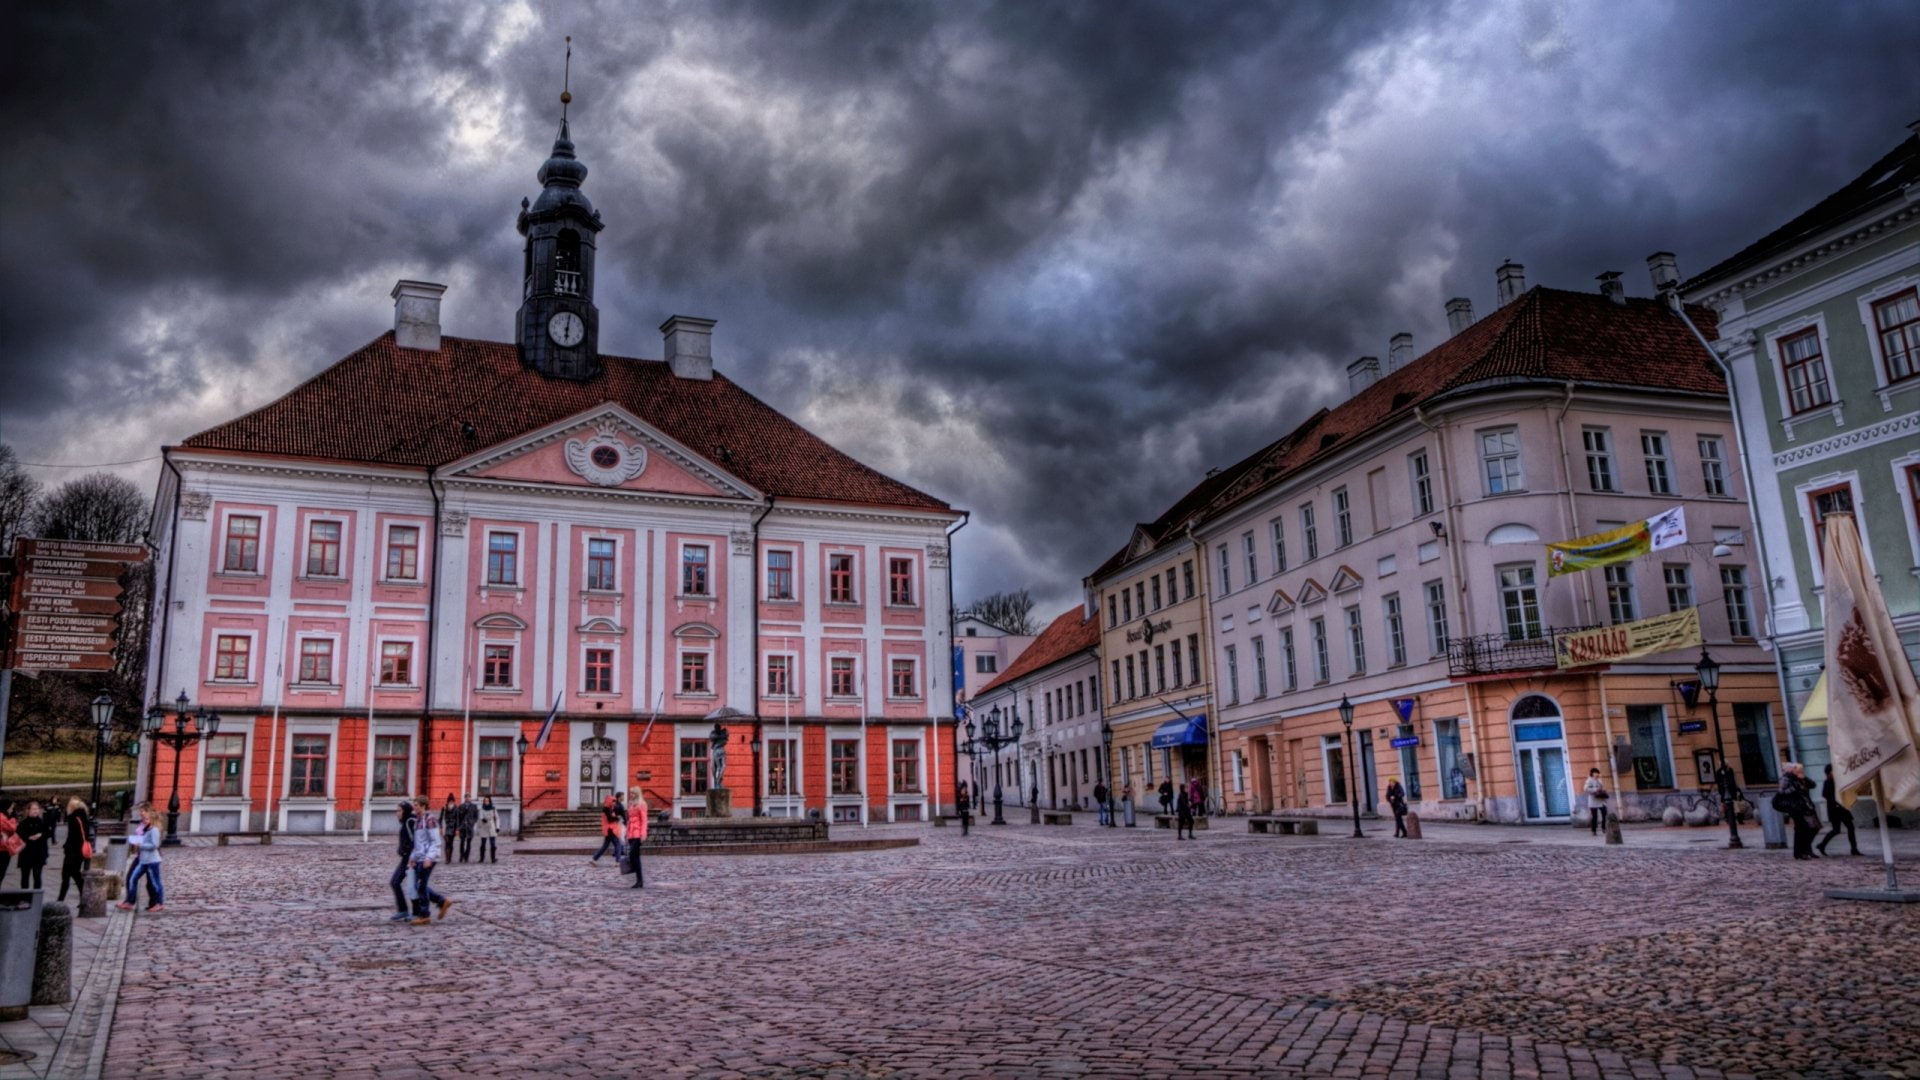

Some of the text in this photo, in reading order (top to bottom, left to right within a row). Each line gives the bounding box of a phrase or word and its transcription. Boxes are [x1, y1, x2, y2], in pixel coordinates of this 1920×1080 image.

[36, 541, 58, 549] TARTU
[30, 598, 52, 606] JAANI
[27, 616, 108, 626] EESTI POSTIMUUSEUM
[46, 636, 107, 645] SPORDIMUUSEUM
